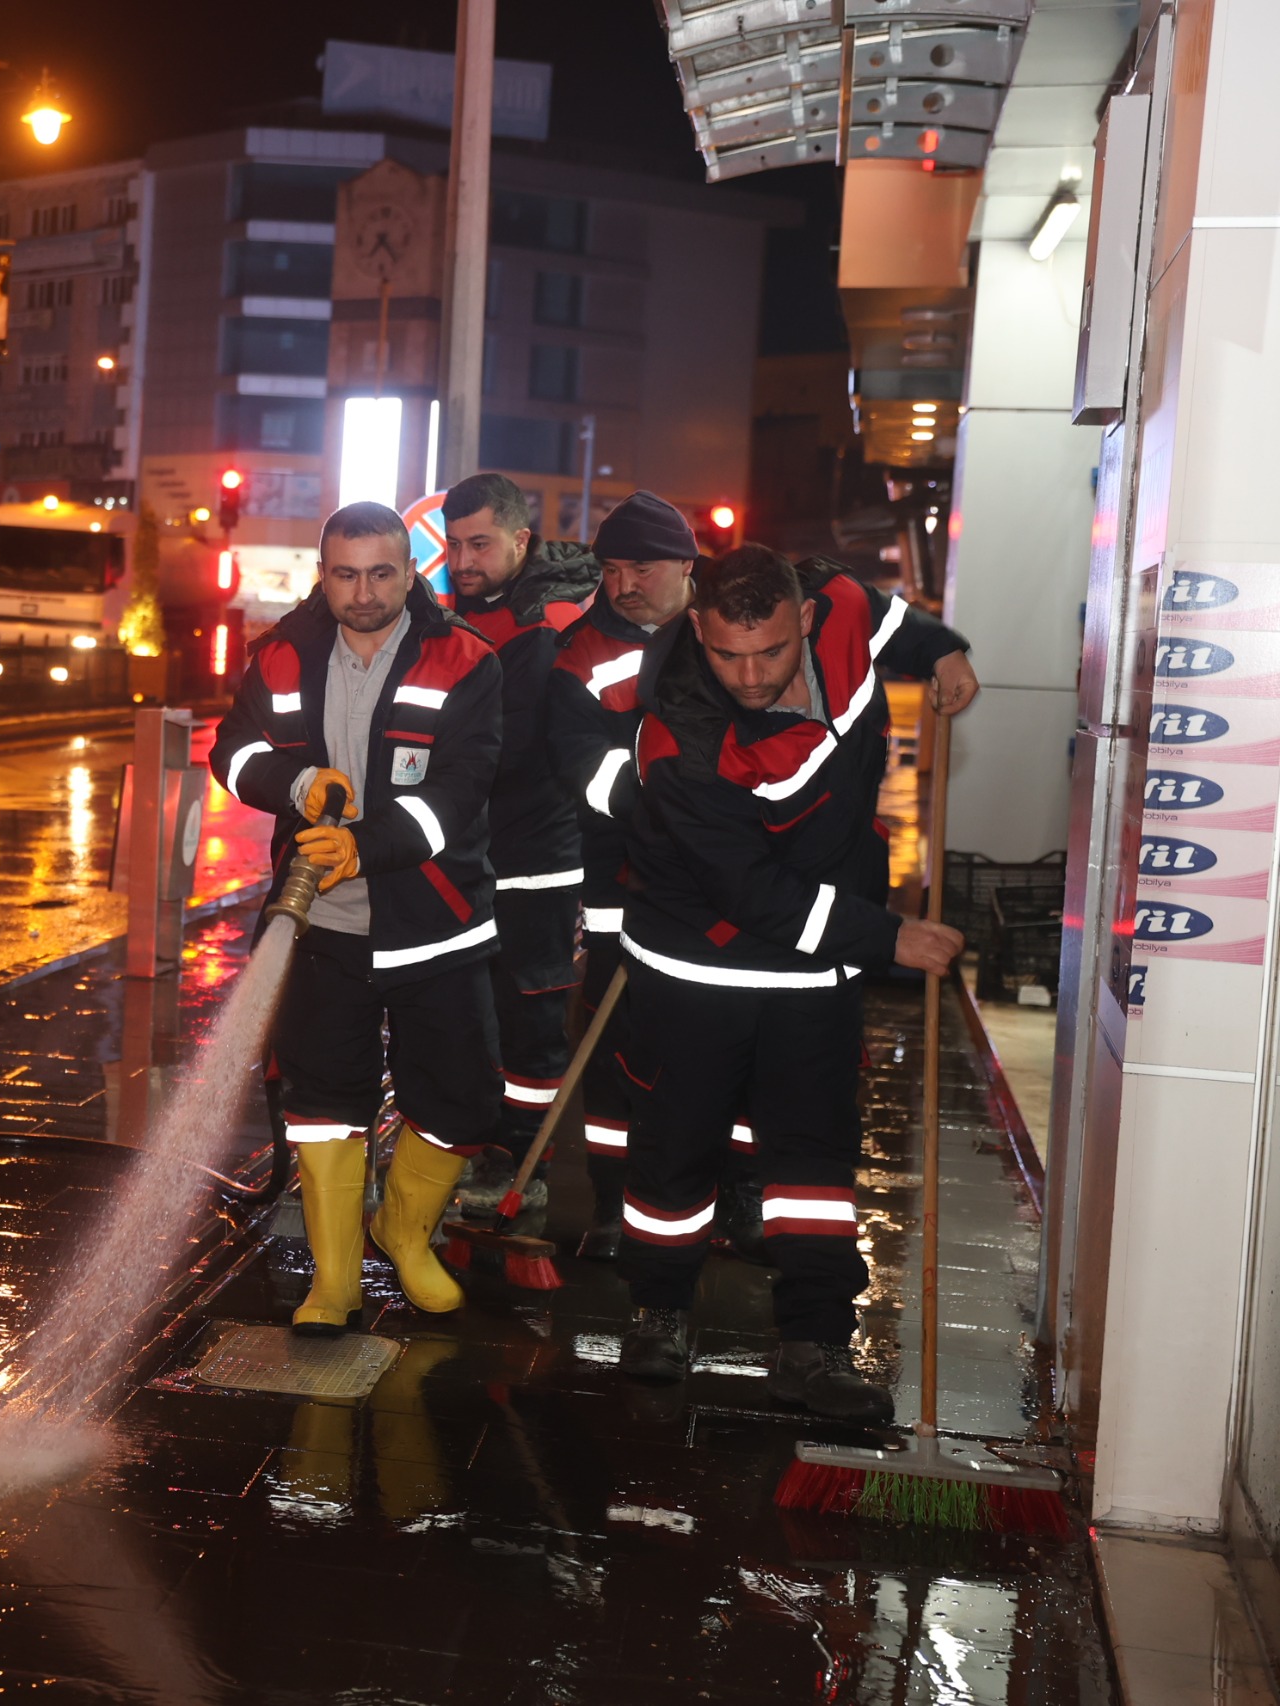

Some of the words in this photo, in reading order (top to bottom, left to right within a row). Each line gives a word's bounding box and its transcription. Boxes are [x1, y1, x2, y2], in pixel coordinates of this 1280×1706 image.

[1148, 746, 1184, 756] obilya
[1142, 812, 1178, 821] obilya
[1132, 943, 1168, 953] obilya
